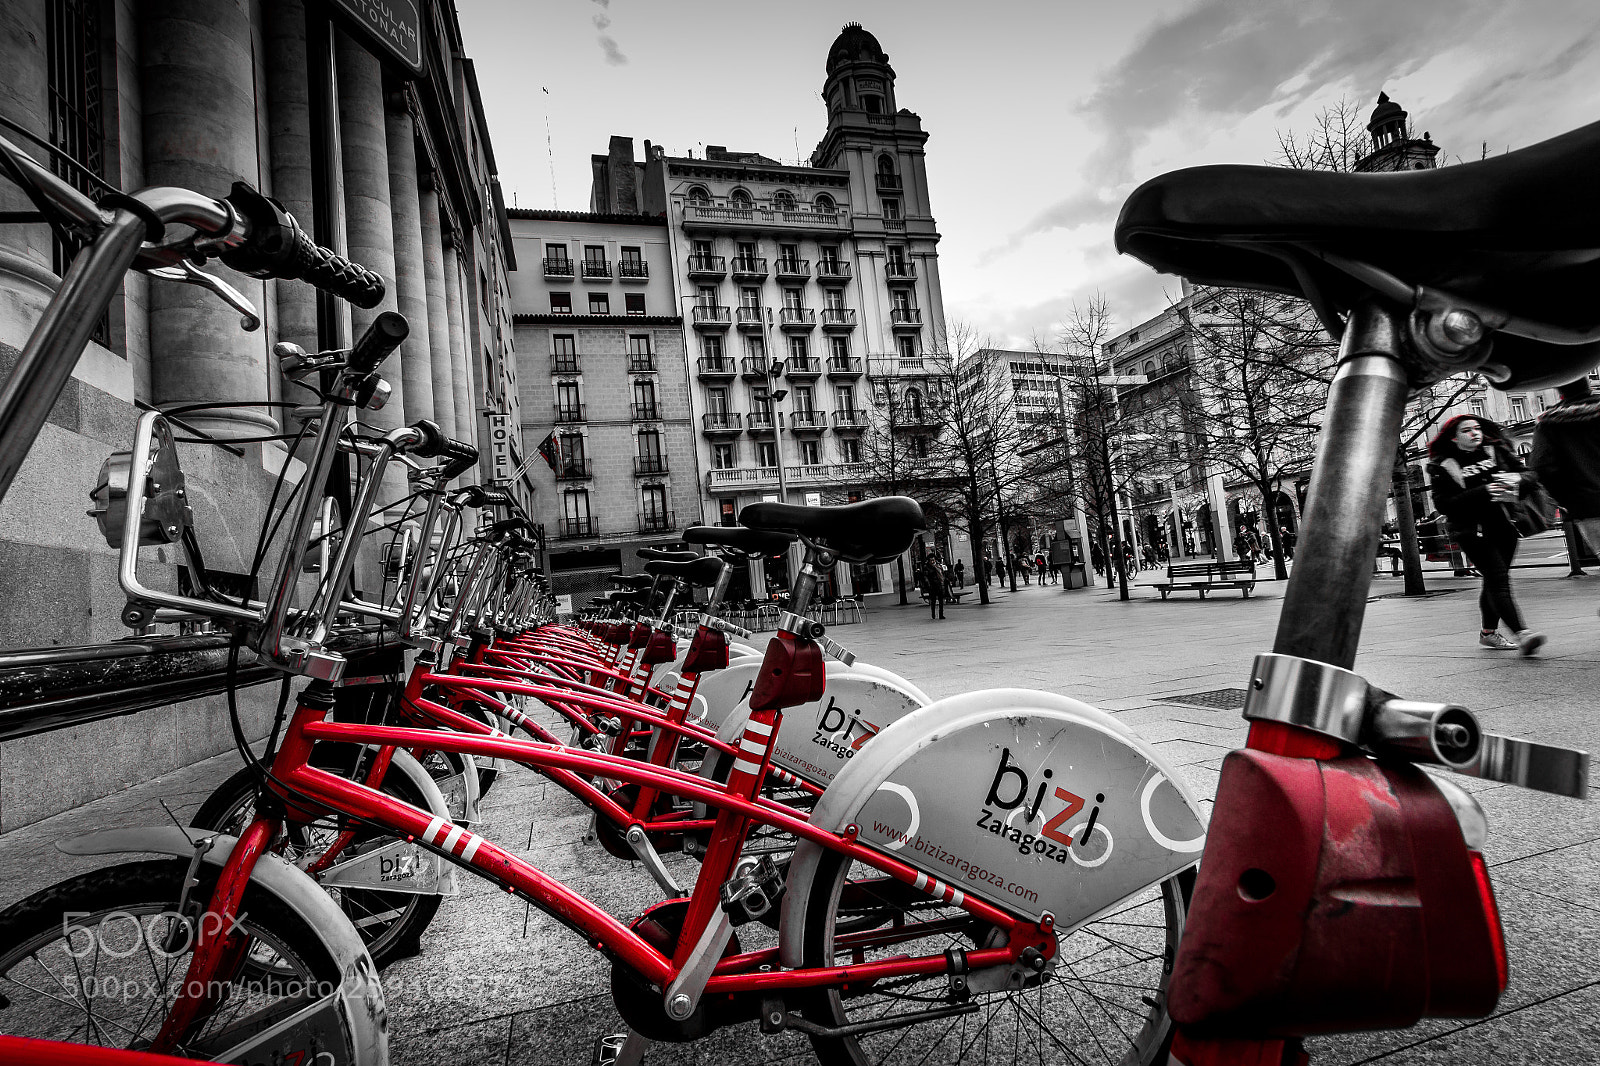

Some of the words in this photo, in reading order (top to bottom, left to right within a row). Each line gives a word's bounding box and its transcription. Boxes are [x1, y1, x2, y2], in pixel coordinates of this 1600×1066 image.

[369, 0, 416, 42] CULAR
[493, 416, 507, 479] HOTEL
[812, 731, 856, 759] Zarago
[818, 696, 890, 751] biz
[774, 746, 836, 781] bizizaragoza.c
[985, 747, 1105, 847] bizi
[380, 850, 419, 875] bizi
[873, 820, 1039, 903] www.bizizaragoza.com
[976, 808, 1068, 864] Zaragoza
